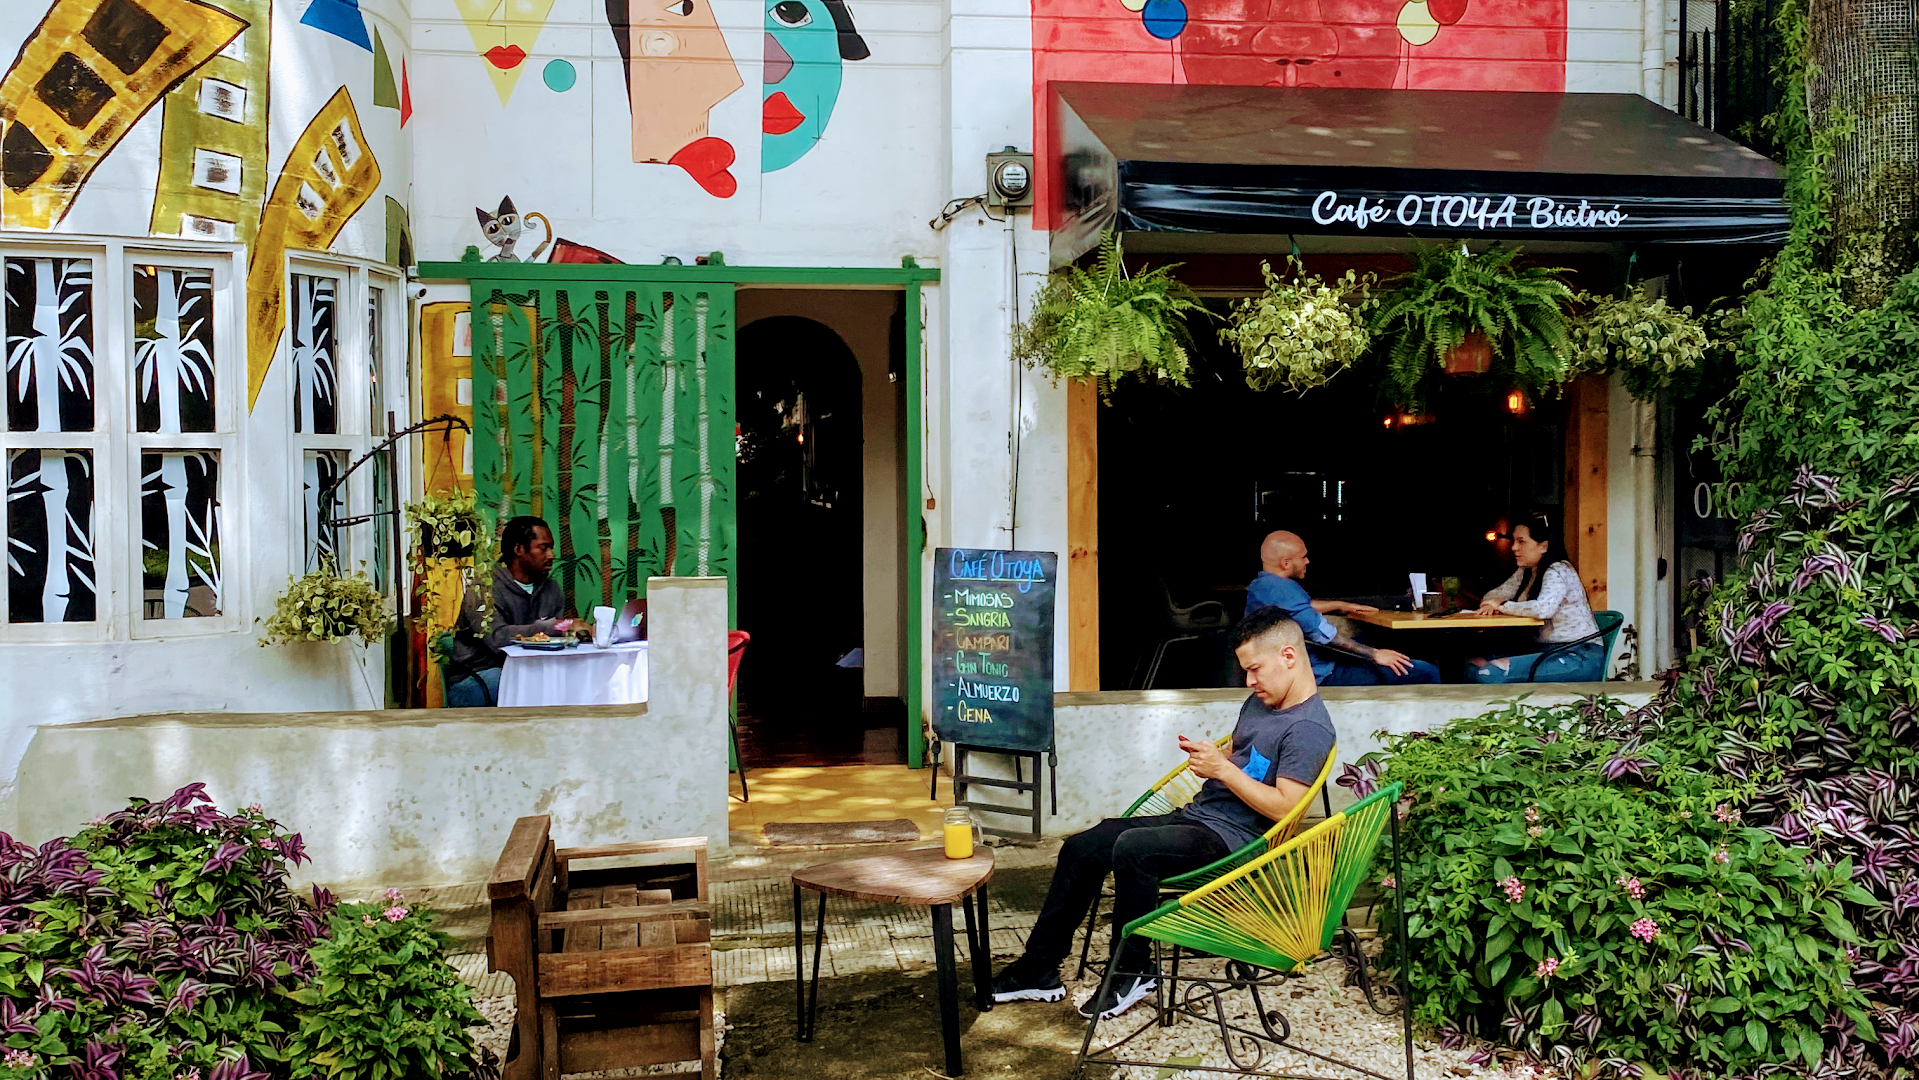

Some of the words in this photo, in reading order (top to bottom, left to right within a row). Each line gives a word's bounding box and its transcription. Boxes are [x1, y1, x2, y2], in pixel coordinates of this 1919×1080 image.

[1311, 190, 1391, 230] Café
[1396, 194, 1518, 230] OTOYA
[1526, 196, 1628, 229] Bistró
[950, 549, 988, 579] CAFÉ
[954, 588, 1014, 609] MIMOSAS
[953, 607, 1011, 627] SANGRIA
[957, 676, 1020, 703] ALMUERZO
[957, 701, 993, 724] CENA
